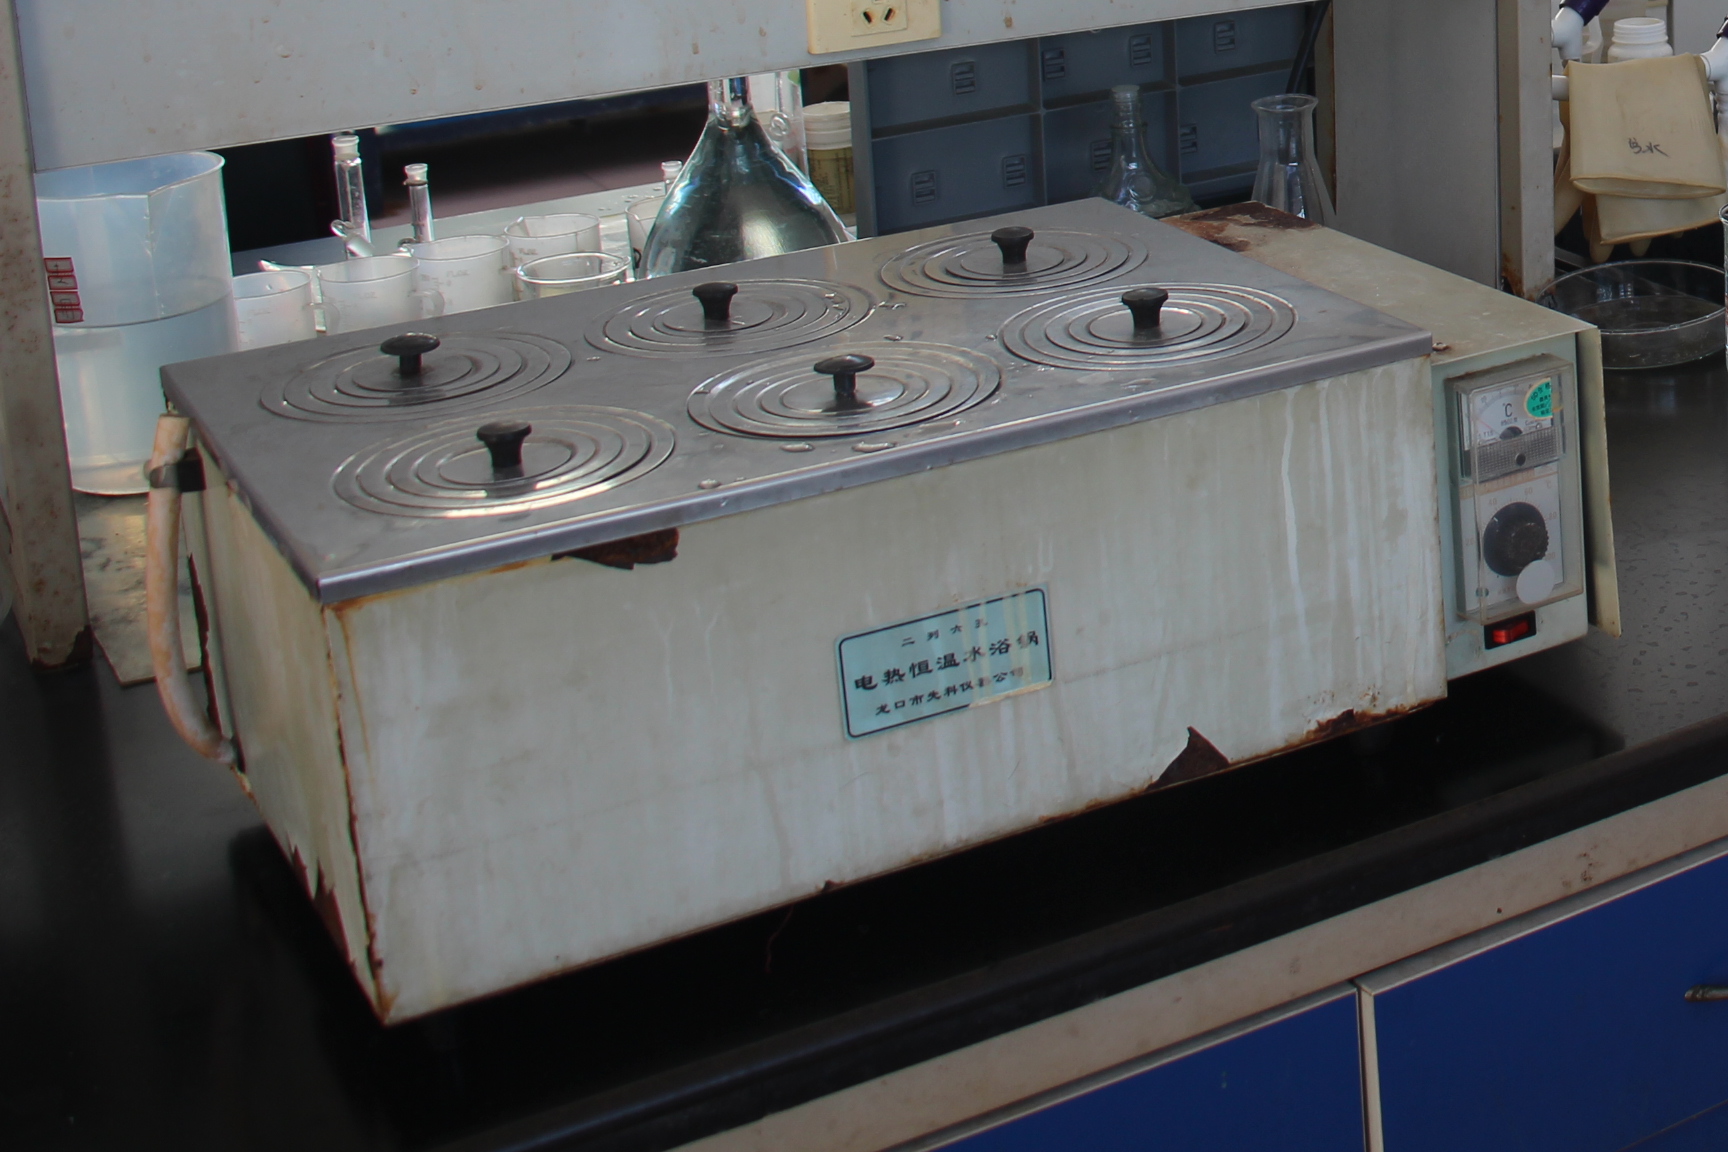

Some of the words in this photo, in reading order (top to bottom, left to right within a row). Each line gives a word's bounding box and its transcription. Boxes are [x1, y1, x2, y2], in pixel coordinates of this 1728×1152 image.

[854, 630, 1039, 691] 电热恒温水浴锅
